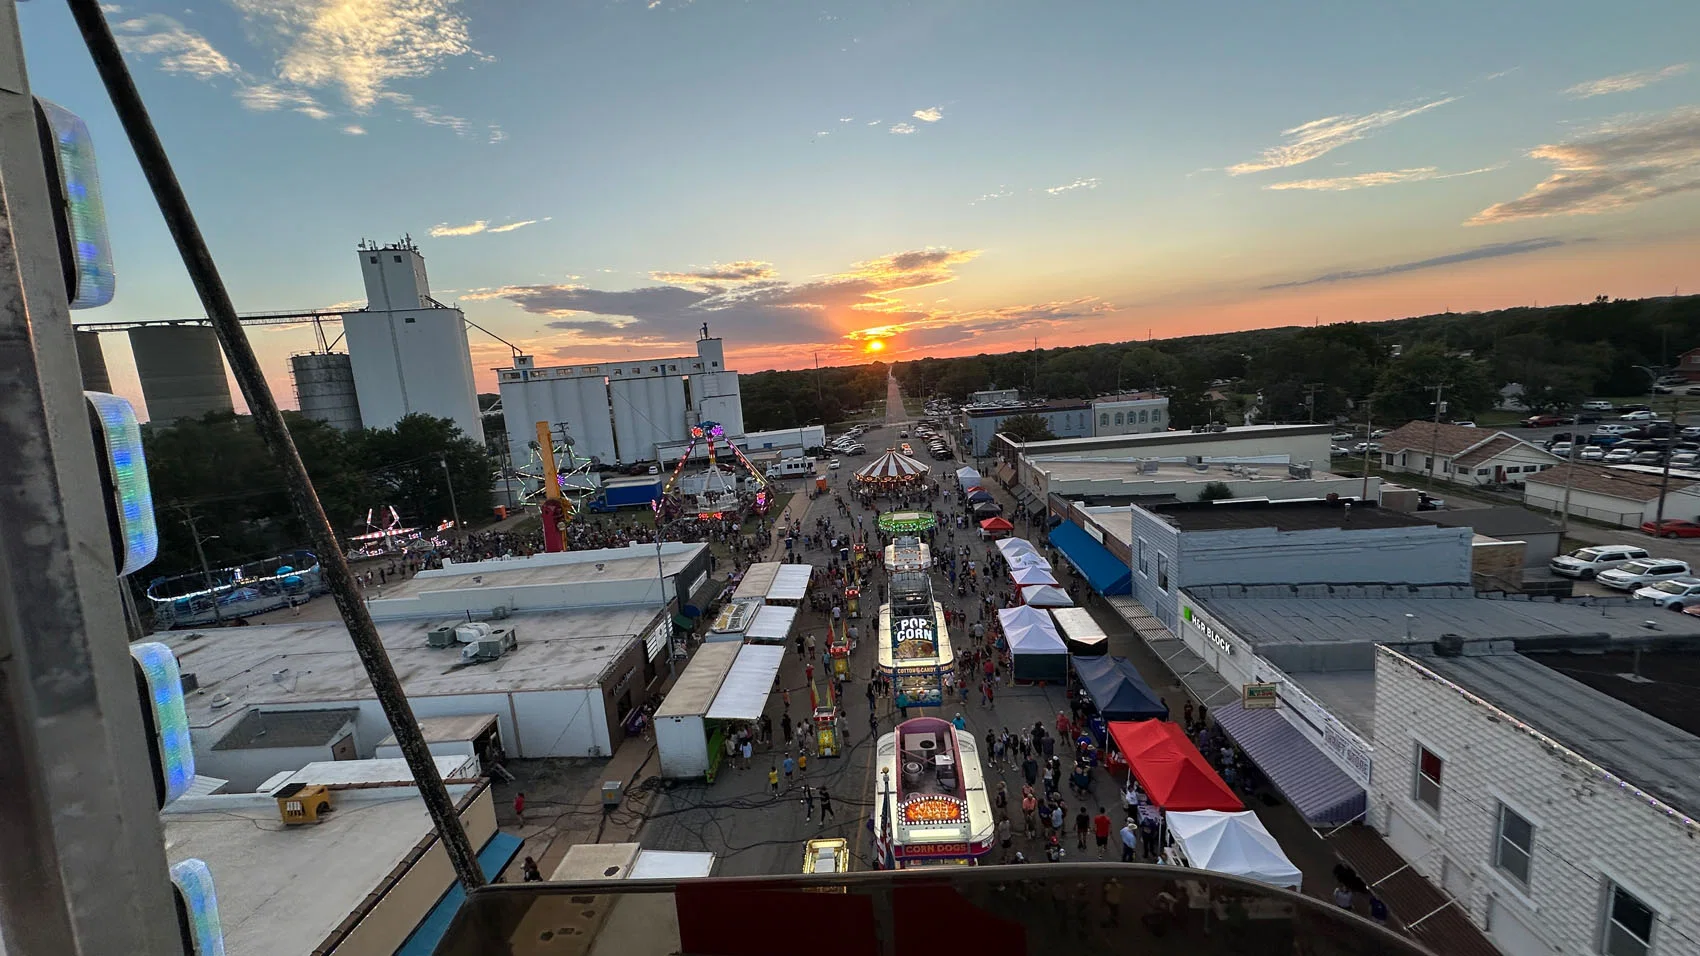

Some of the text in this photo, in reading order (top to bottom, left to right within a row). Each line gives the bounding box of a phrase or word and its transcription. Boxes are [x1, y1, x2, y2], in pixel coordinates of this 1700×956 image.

[901, 618, 927, 631] POP
[897, 629, 933, 642] CORN
[1192, 614, 1231, 655] H&R BLOCK
[906, 844, 967, 853] CORN DOGS
